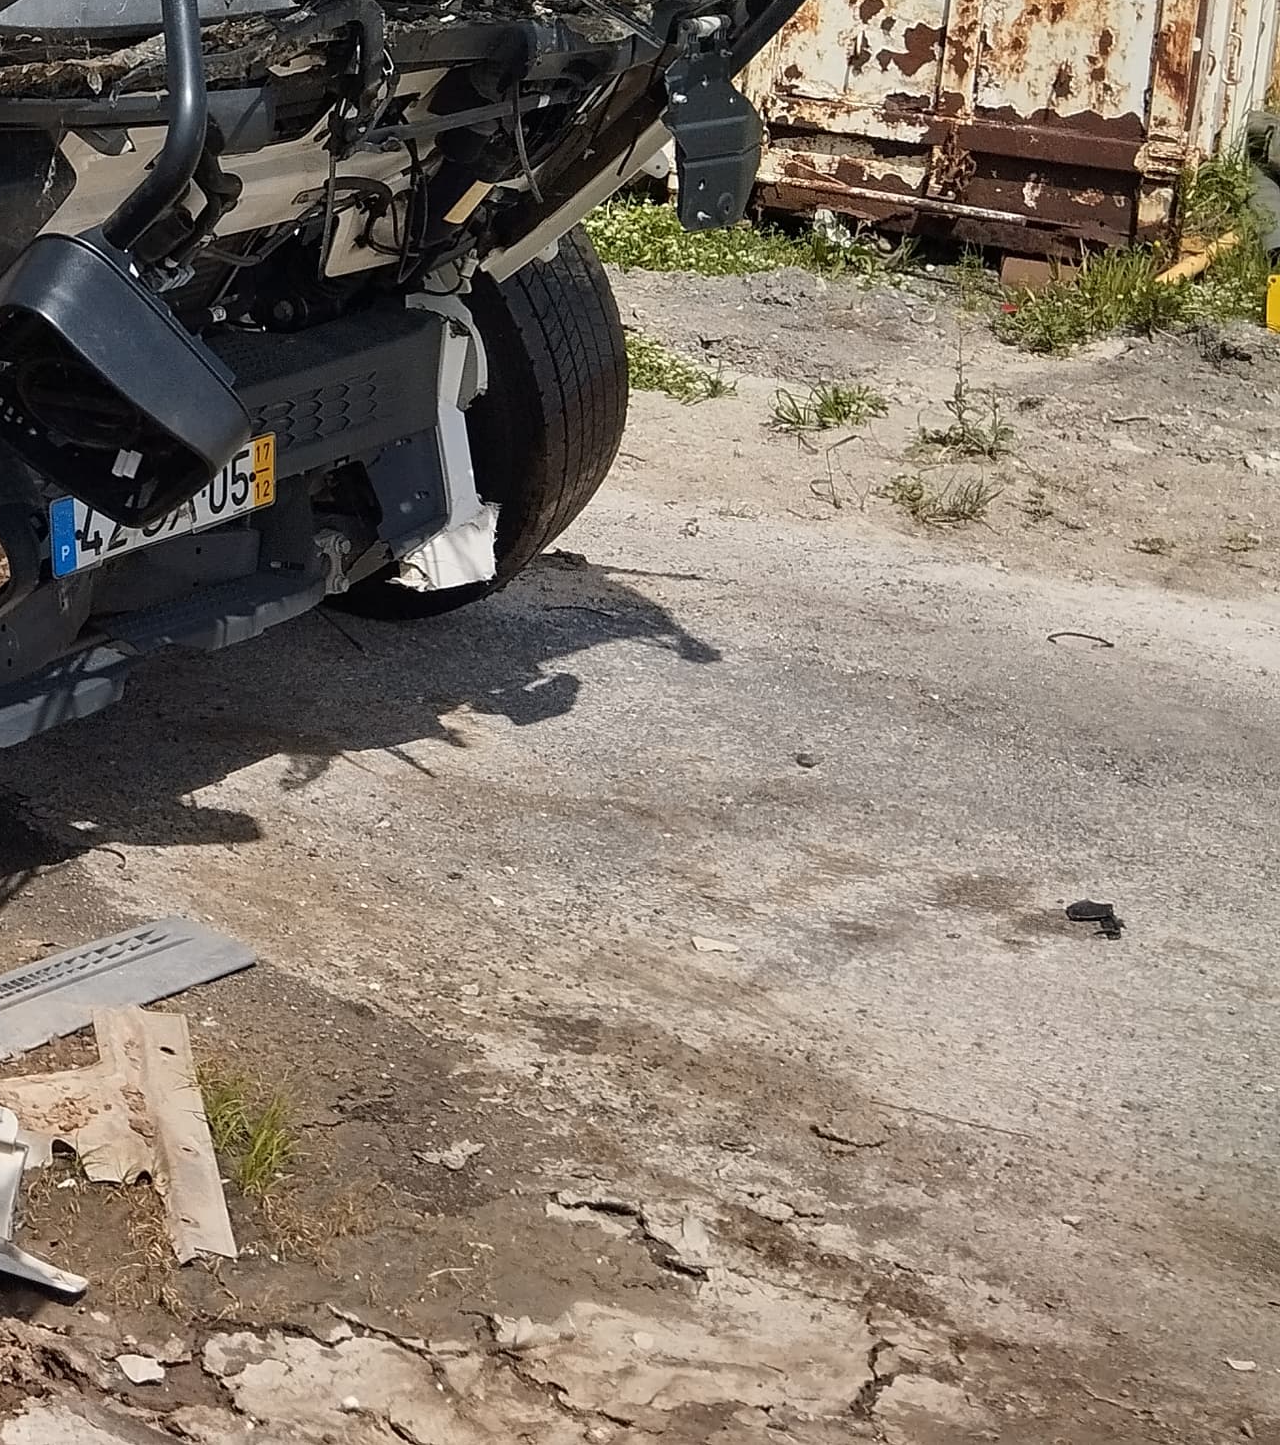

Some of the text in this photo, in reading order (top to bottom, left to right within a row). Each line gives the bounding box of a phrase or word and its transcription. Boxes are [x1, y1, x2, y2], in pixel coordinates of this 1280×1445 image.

[256, 442, 270, 463] 17
[256, 480, 270, 500] 12
[61, 545, 71, 562] P
